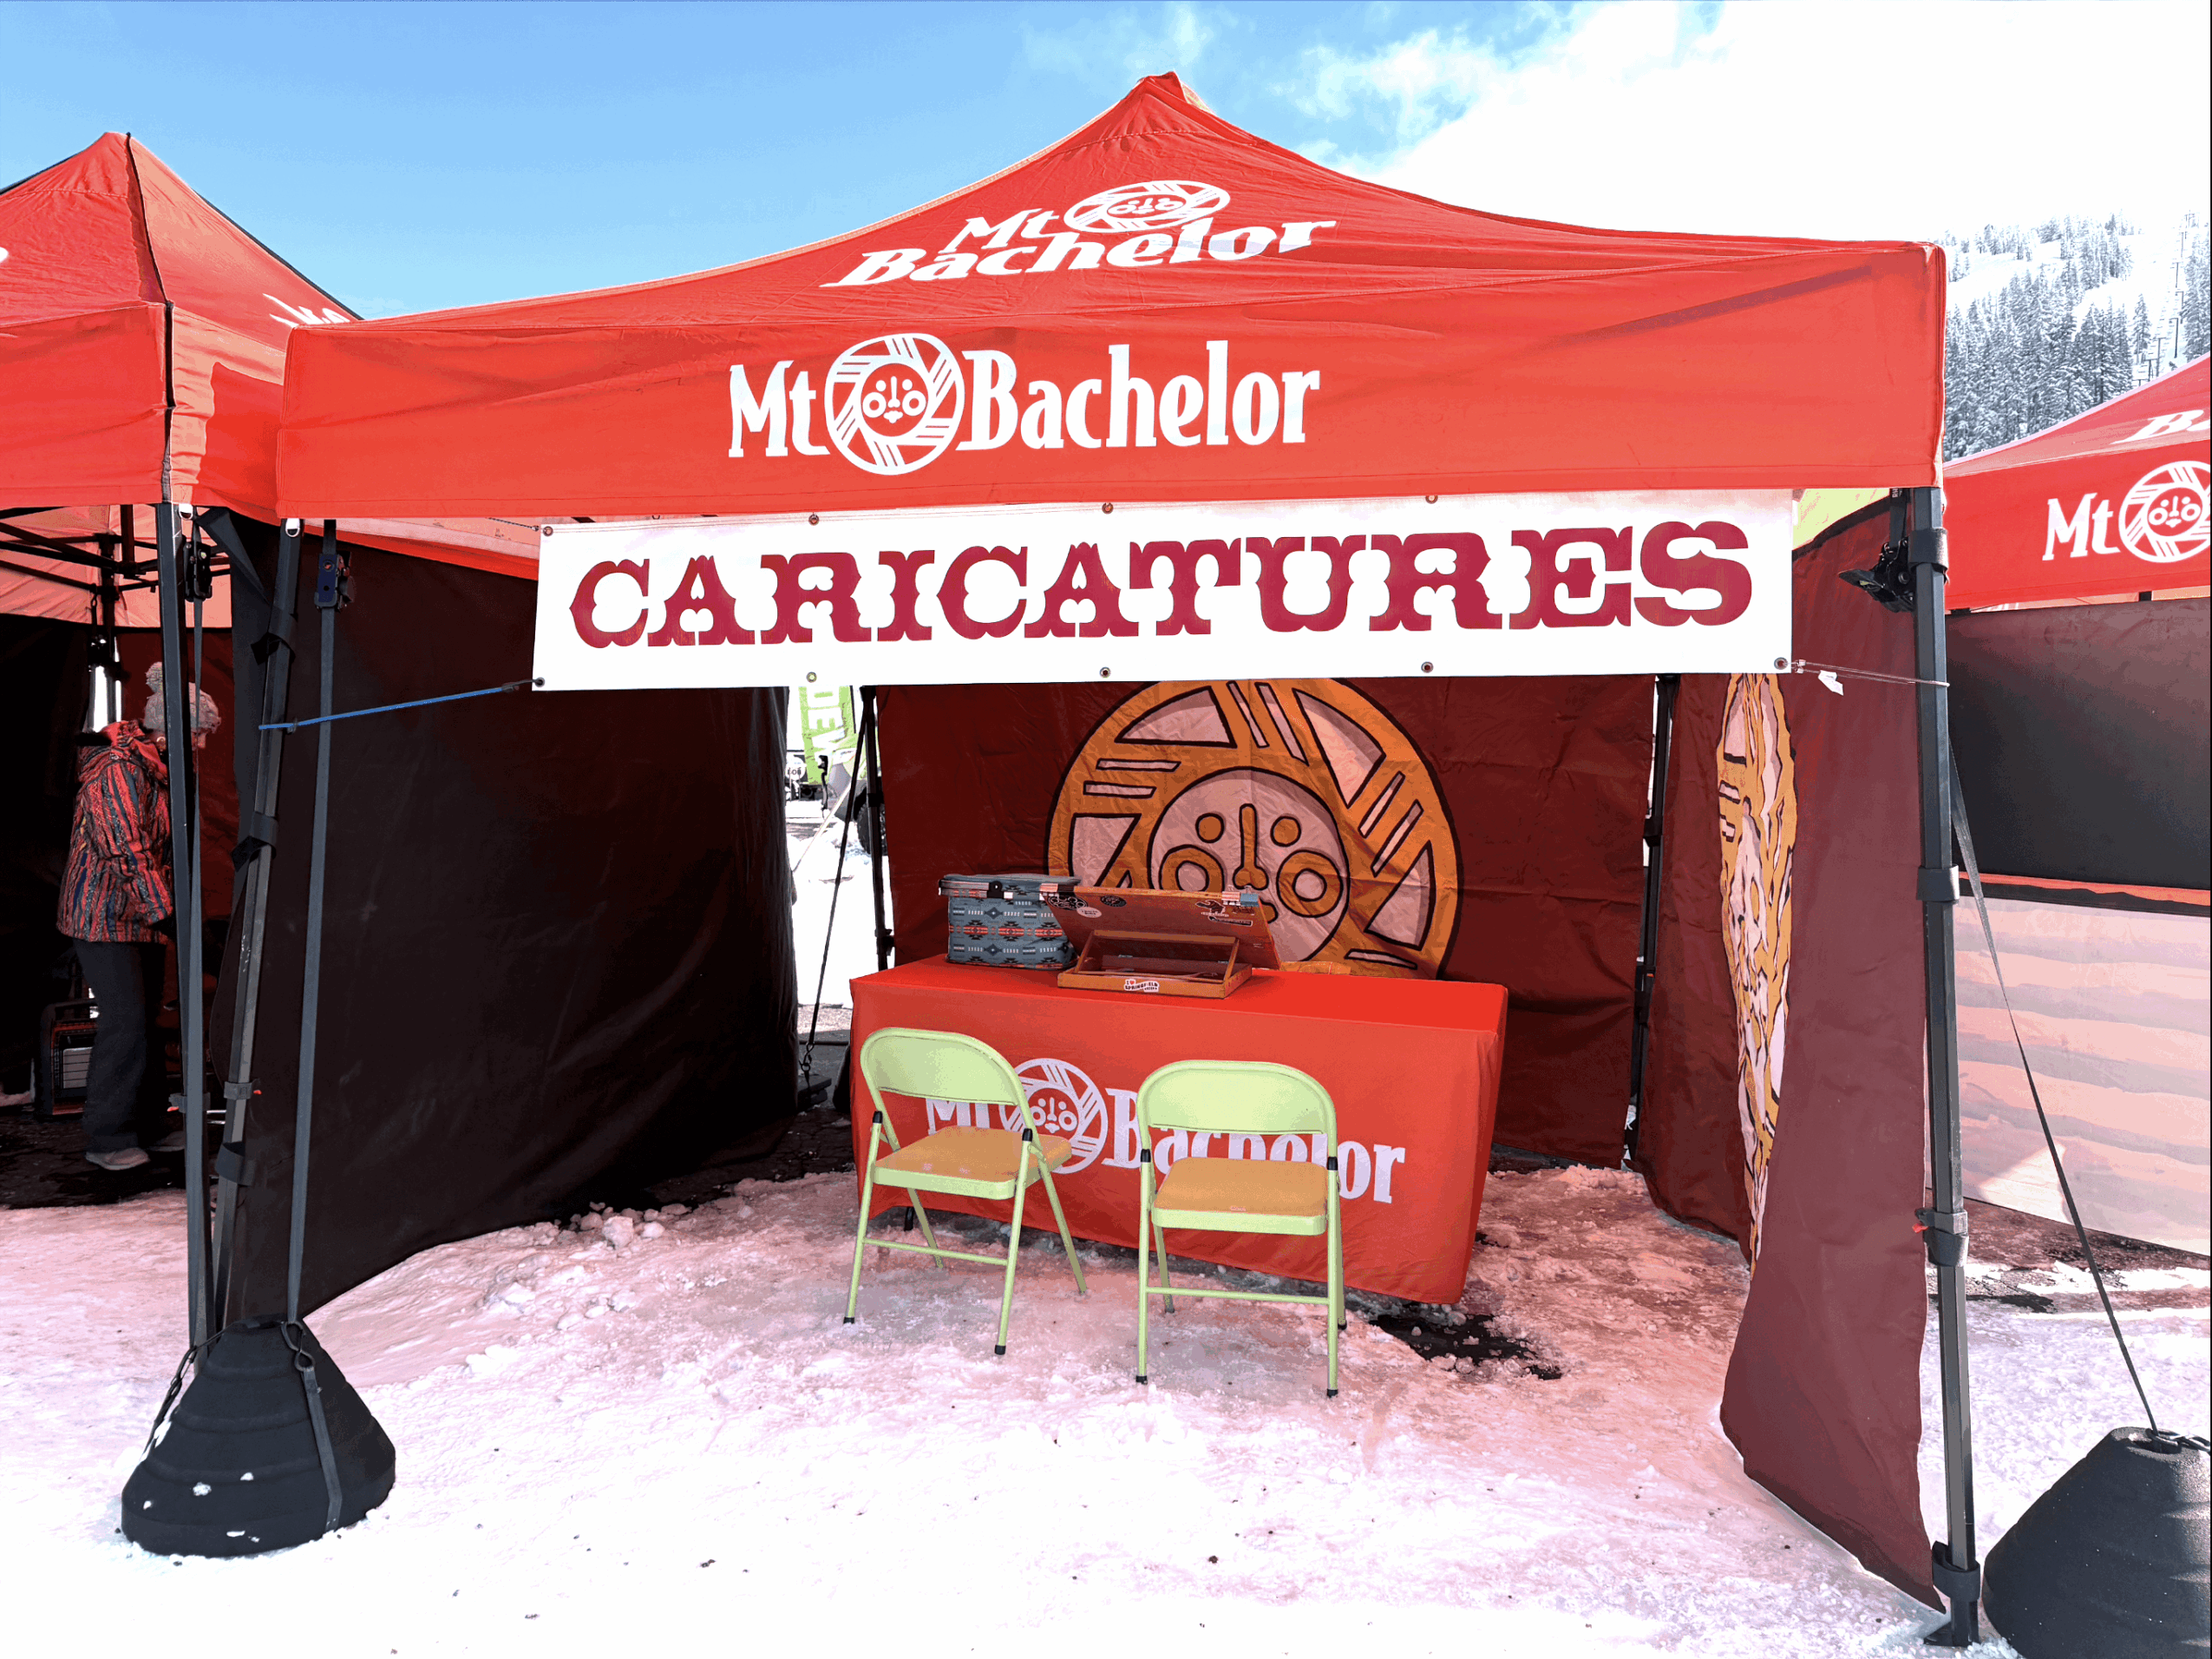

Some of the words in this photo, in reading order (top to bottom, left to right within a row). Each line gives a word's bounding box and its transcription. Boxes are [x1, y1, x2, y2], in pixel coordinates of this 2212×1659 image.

[819, 217, 1337, 288] Bachelor
[944, 208, 1059, 252] Mt
[728, 360, 830, 458] Mt
[955, 340, 1321, 451] Bachelor
[2041, 492, 2122, 561] Mt
[569, 520, 1752, 648] CARICATURES
